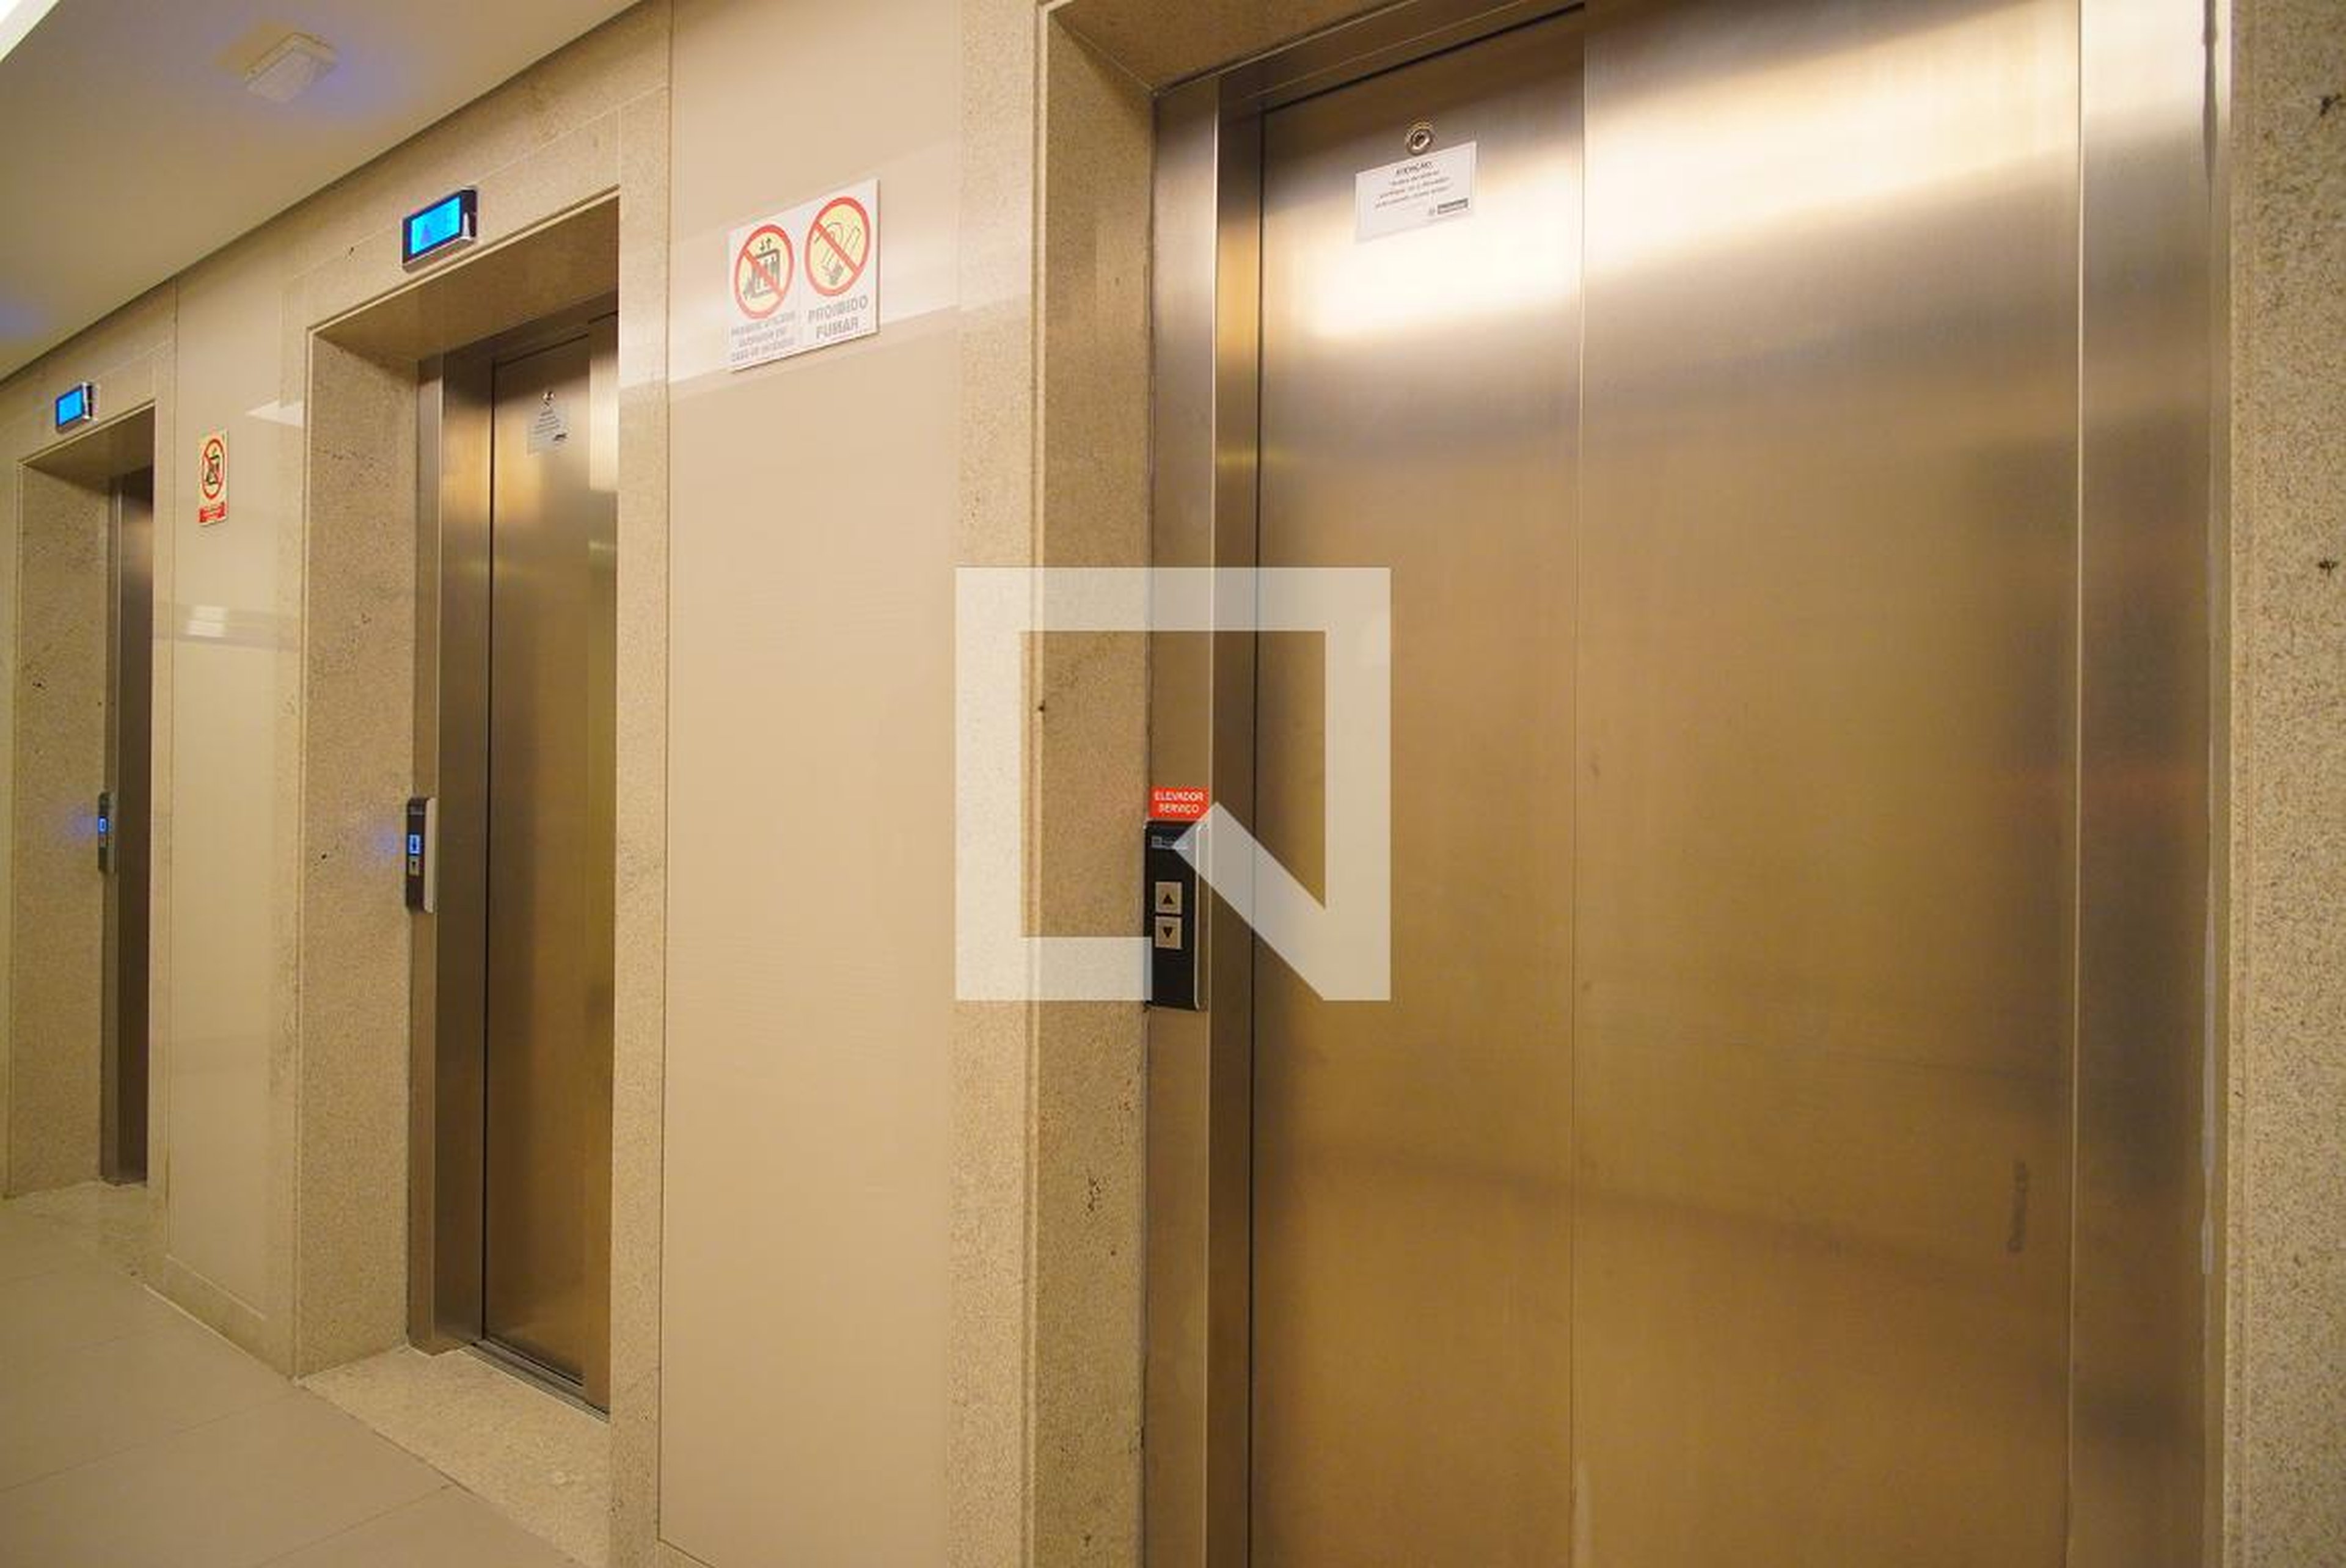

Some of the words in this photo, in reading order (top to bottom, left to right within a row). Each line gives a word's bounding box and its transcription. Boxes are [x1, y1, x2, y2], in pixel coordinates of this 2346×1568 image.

[808, 295, 868, 324] PROIBIDO
[816, 316, 858, 339] FUMAR
[1155, 790, 1204, 801] ELEVADOR
[1159, 803, 1199, 815] SERVIÇO
